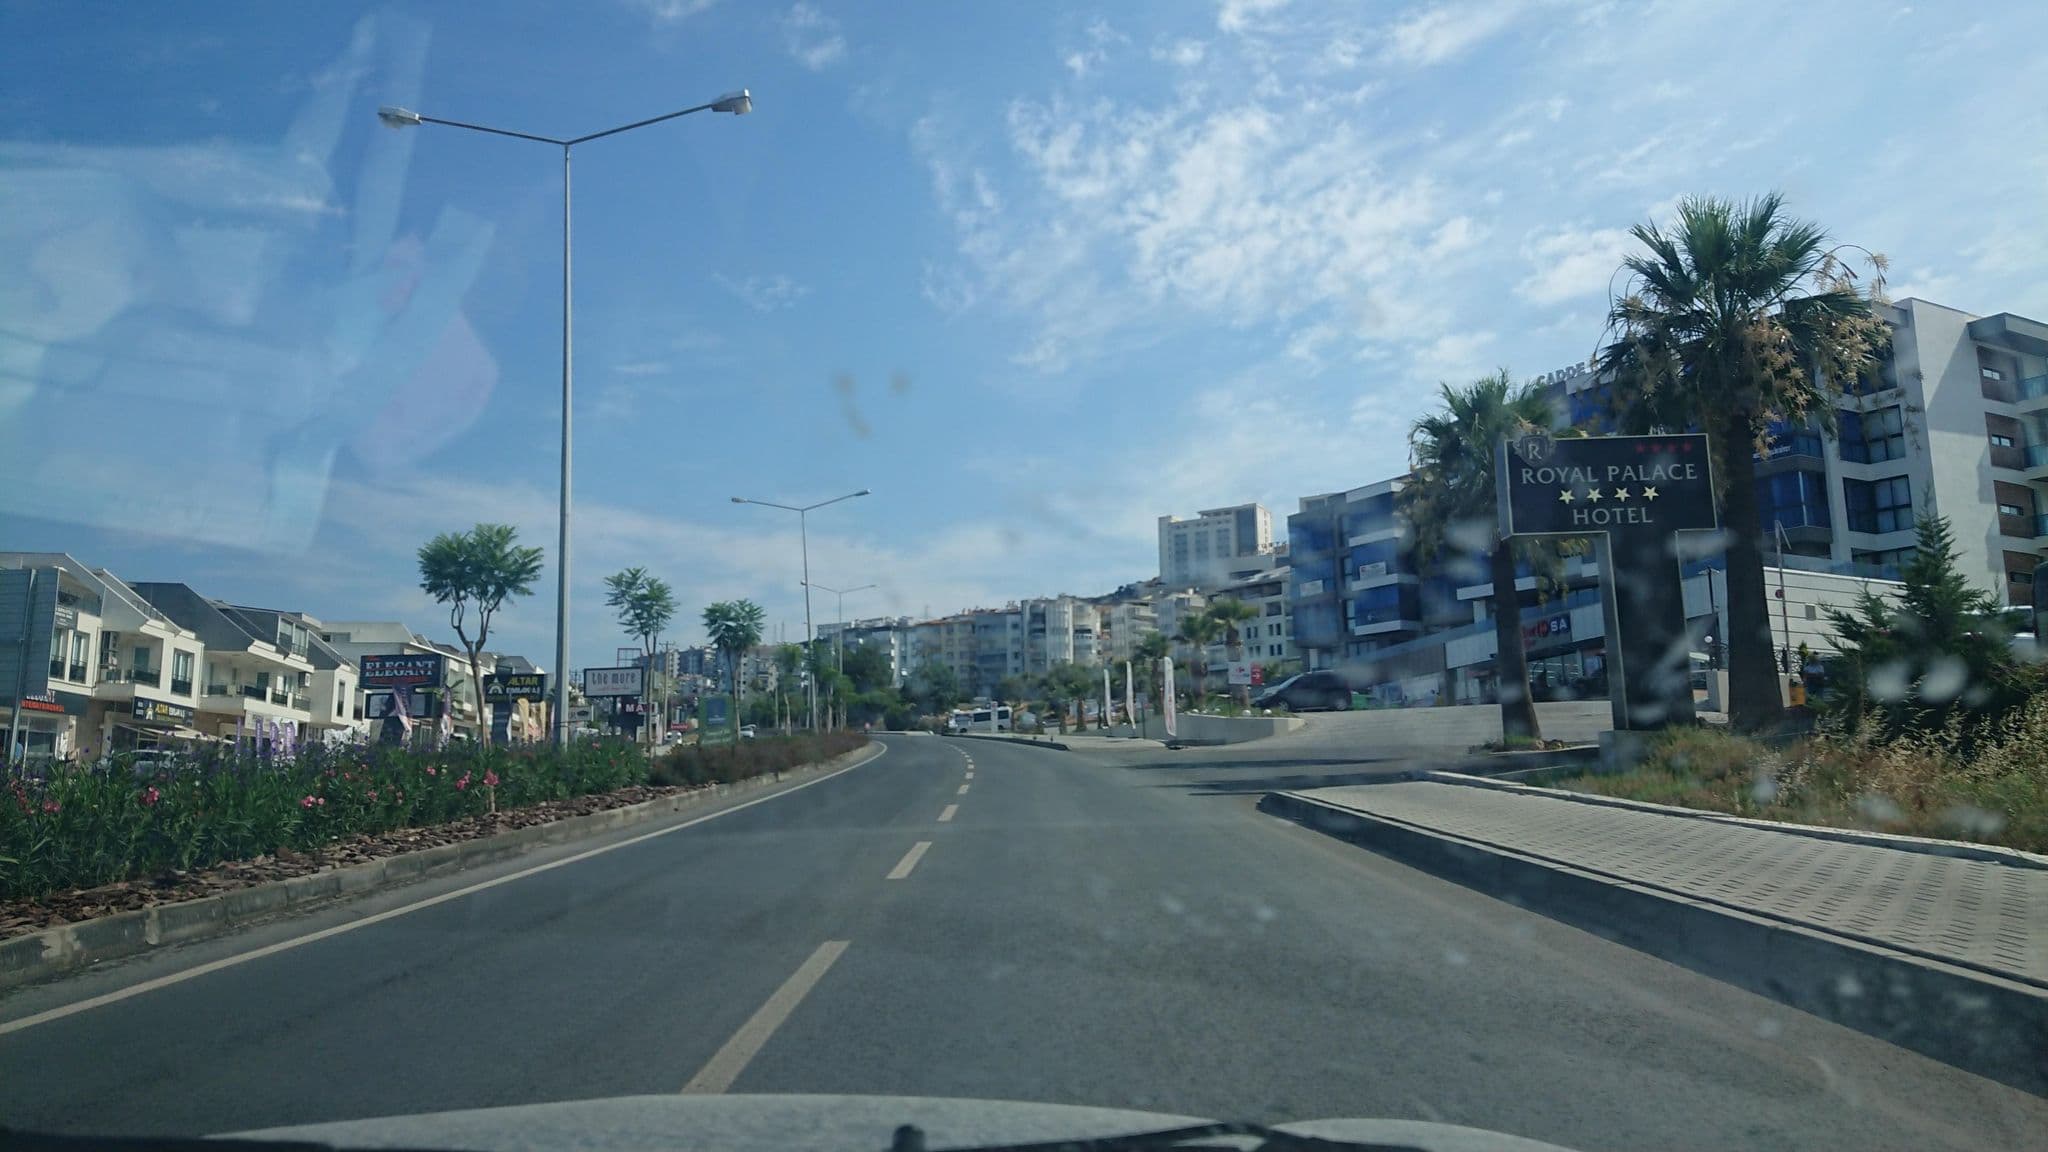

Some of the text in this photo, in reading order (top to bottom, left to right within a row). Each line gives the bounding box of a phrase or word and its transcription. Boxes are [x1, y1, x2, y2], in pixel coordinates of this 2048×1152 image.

[1522, 463, 1698, 485] ROYAL PALACE
[1572, 507, 1653, 526] HOTEL
[365, 660, 435, 677] ELEGANT
[508, 677, 538, 686] ALTAR
[612, 672, 636, 685] more
